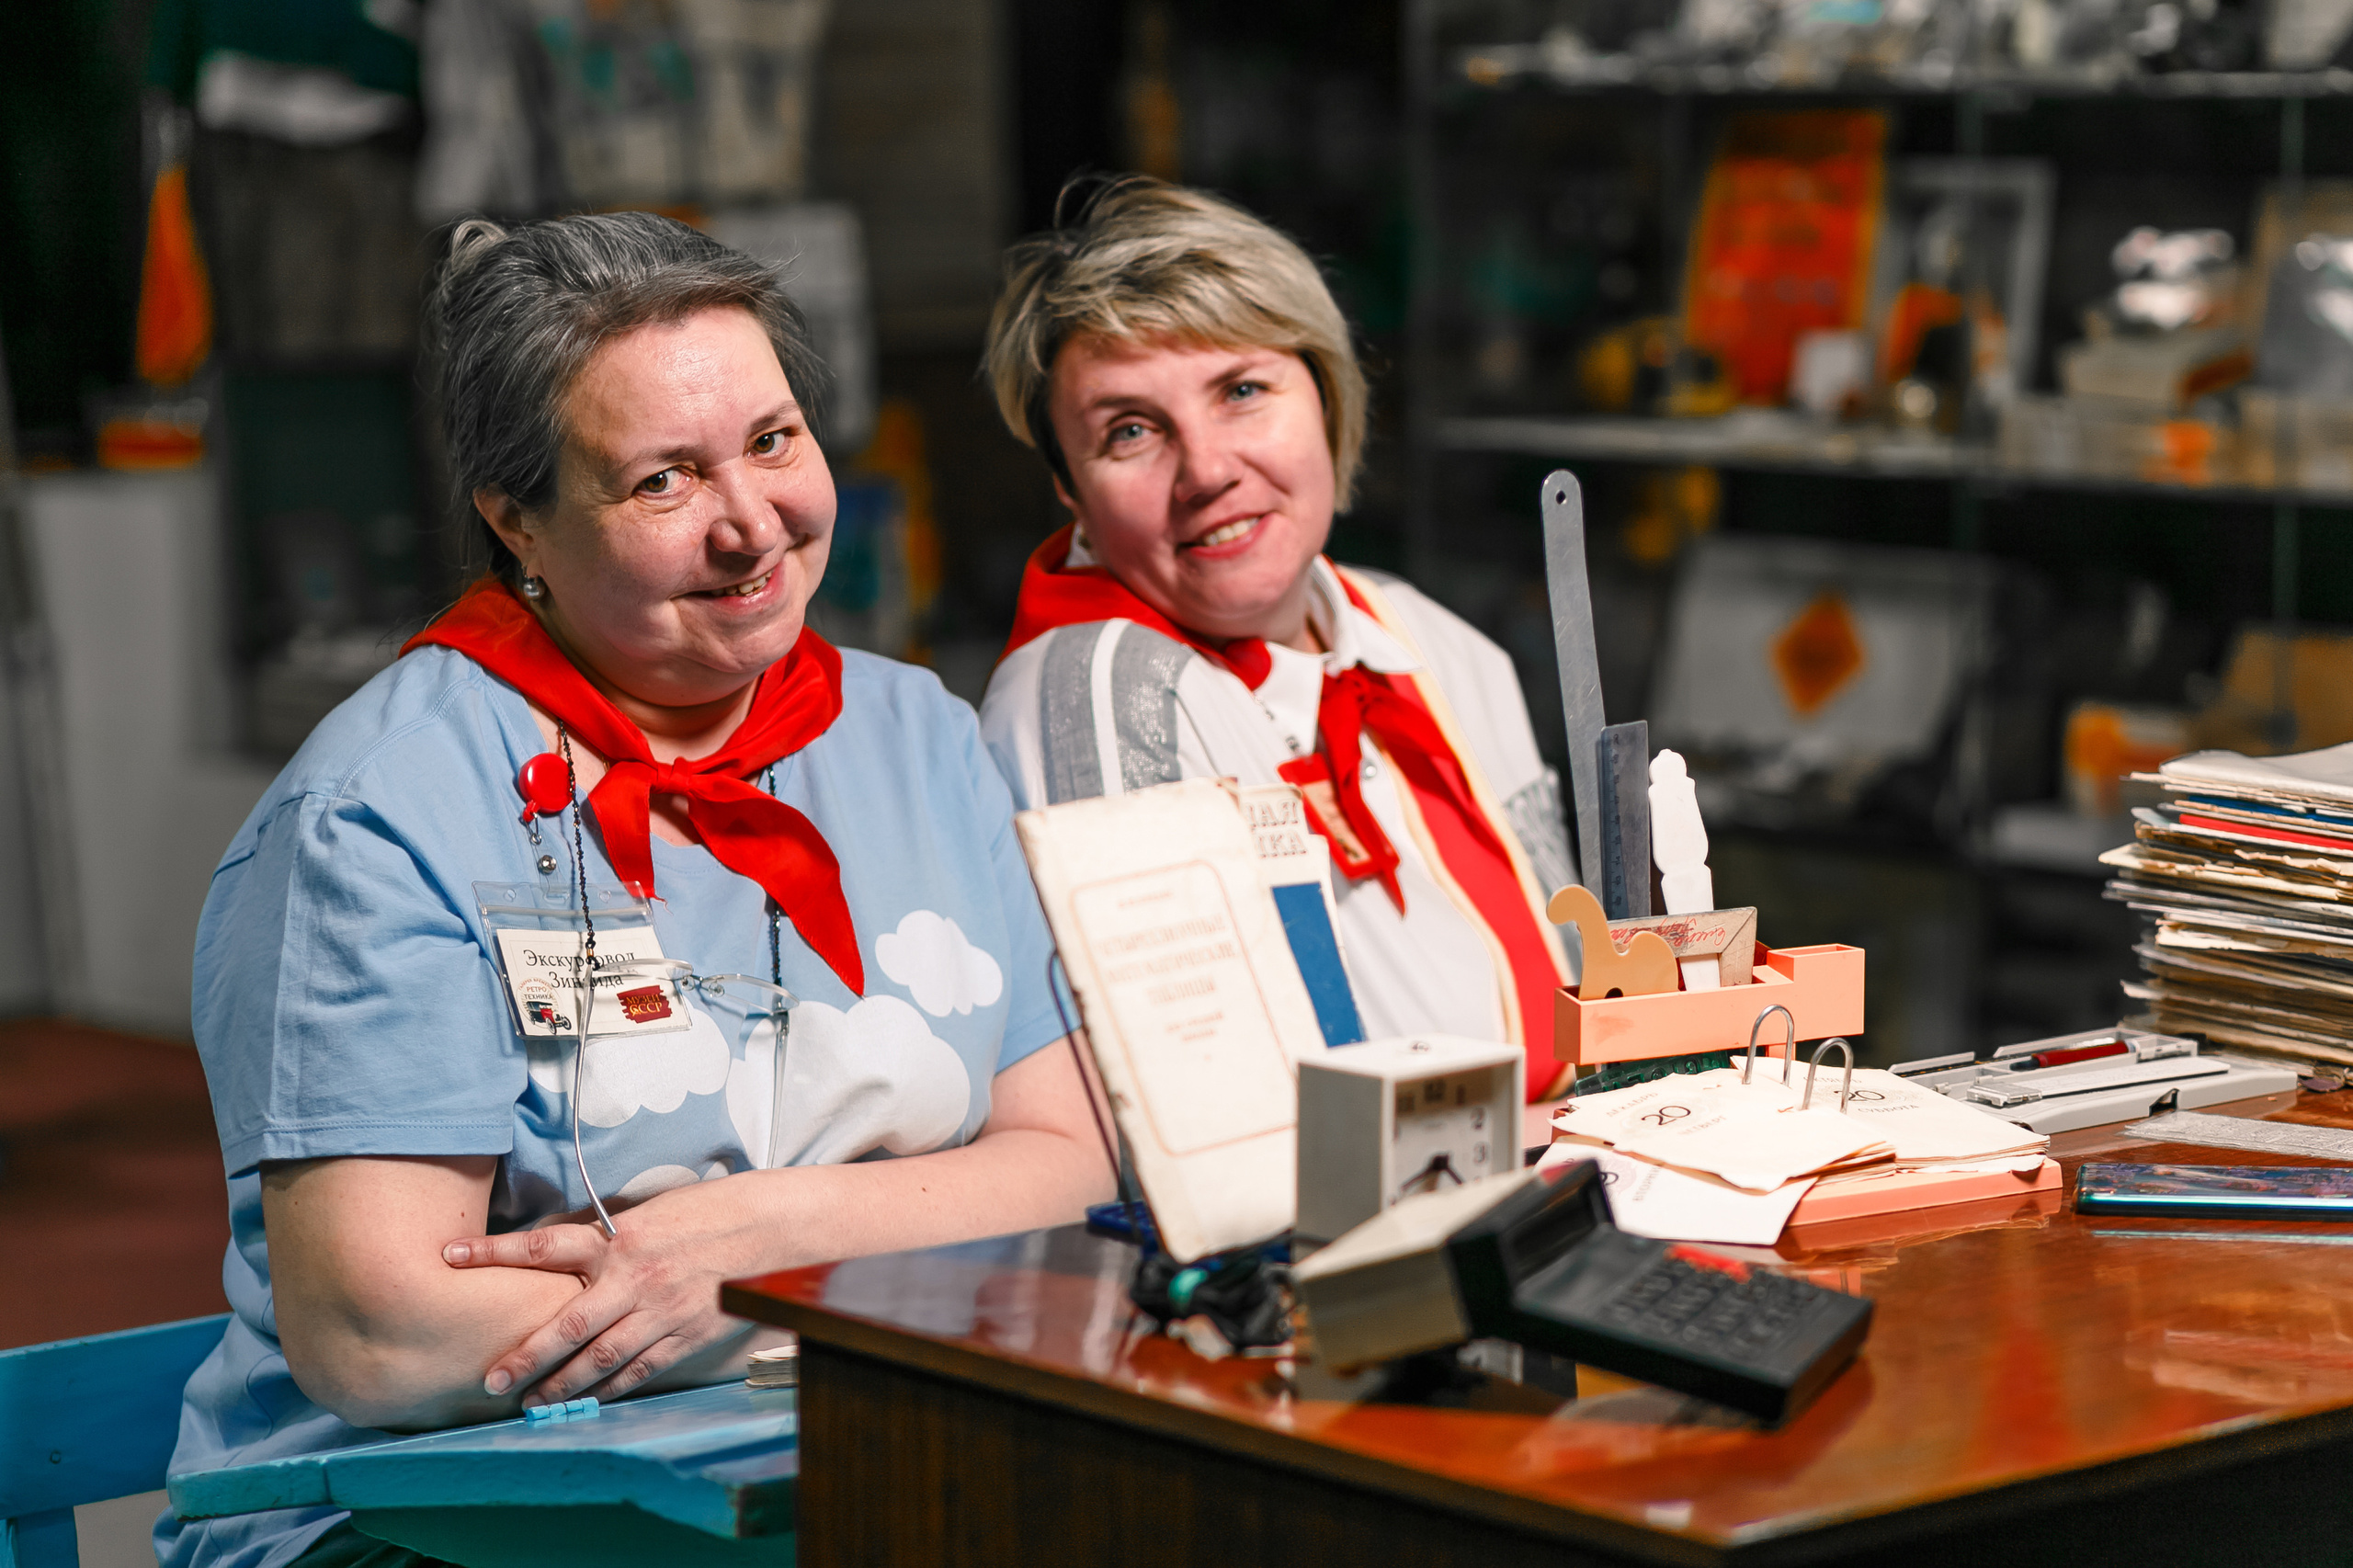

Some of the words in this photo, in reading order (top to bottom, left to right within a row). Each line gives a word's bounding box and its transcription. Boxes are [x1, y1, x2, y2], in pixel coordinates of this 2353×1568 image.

[523, 949, 635, 971] Экскуровод
[549, 971, 624, 989] Зинида
[630, 1002, 662, 1017] СССР
[1641, 1105, 1691, 1126] 20
